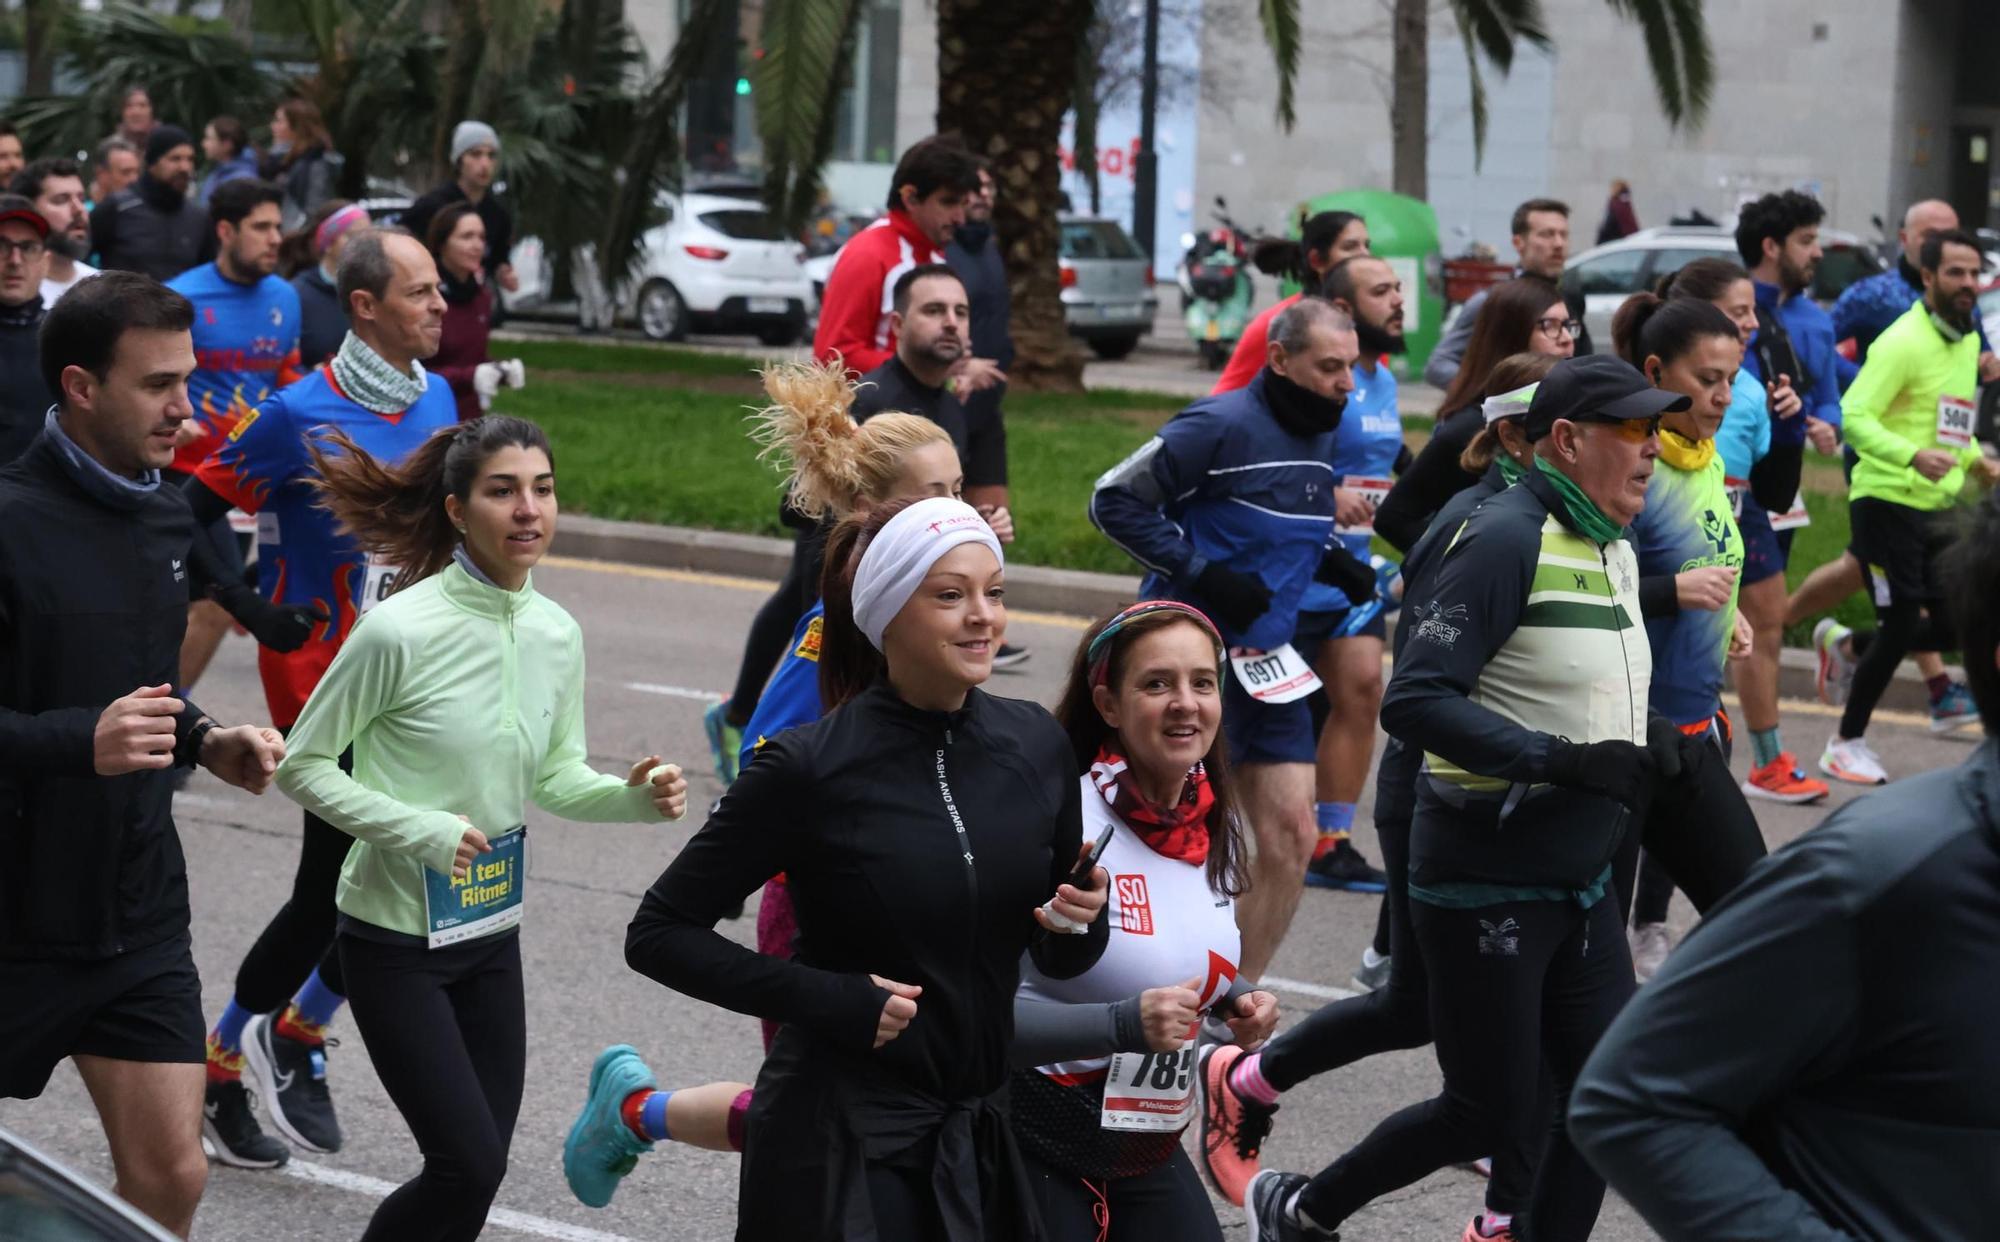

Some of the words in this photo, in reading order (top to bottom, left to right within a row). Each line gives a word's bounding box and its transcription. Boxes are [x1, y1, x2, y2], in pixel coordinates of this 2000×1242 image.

[1242, 655, 1288, 686] 6977
[936, 749, 946, 779] DASH
[939, 781, 953, 803] AND
[946, 804, 966, 834] STARS
[476, 859, 506, 882] teu
[461, 881, 509, 909] Ritme
